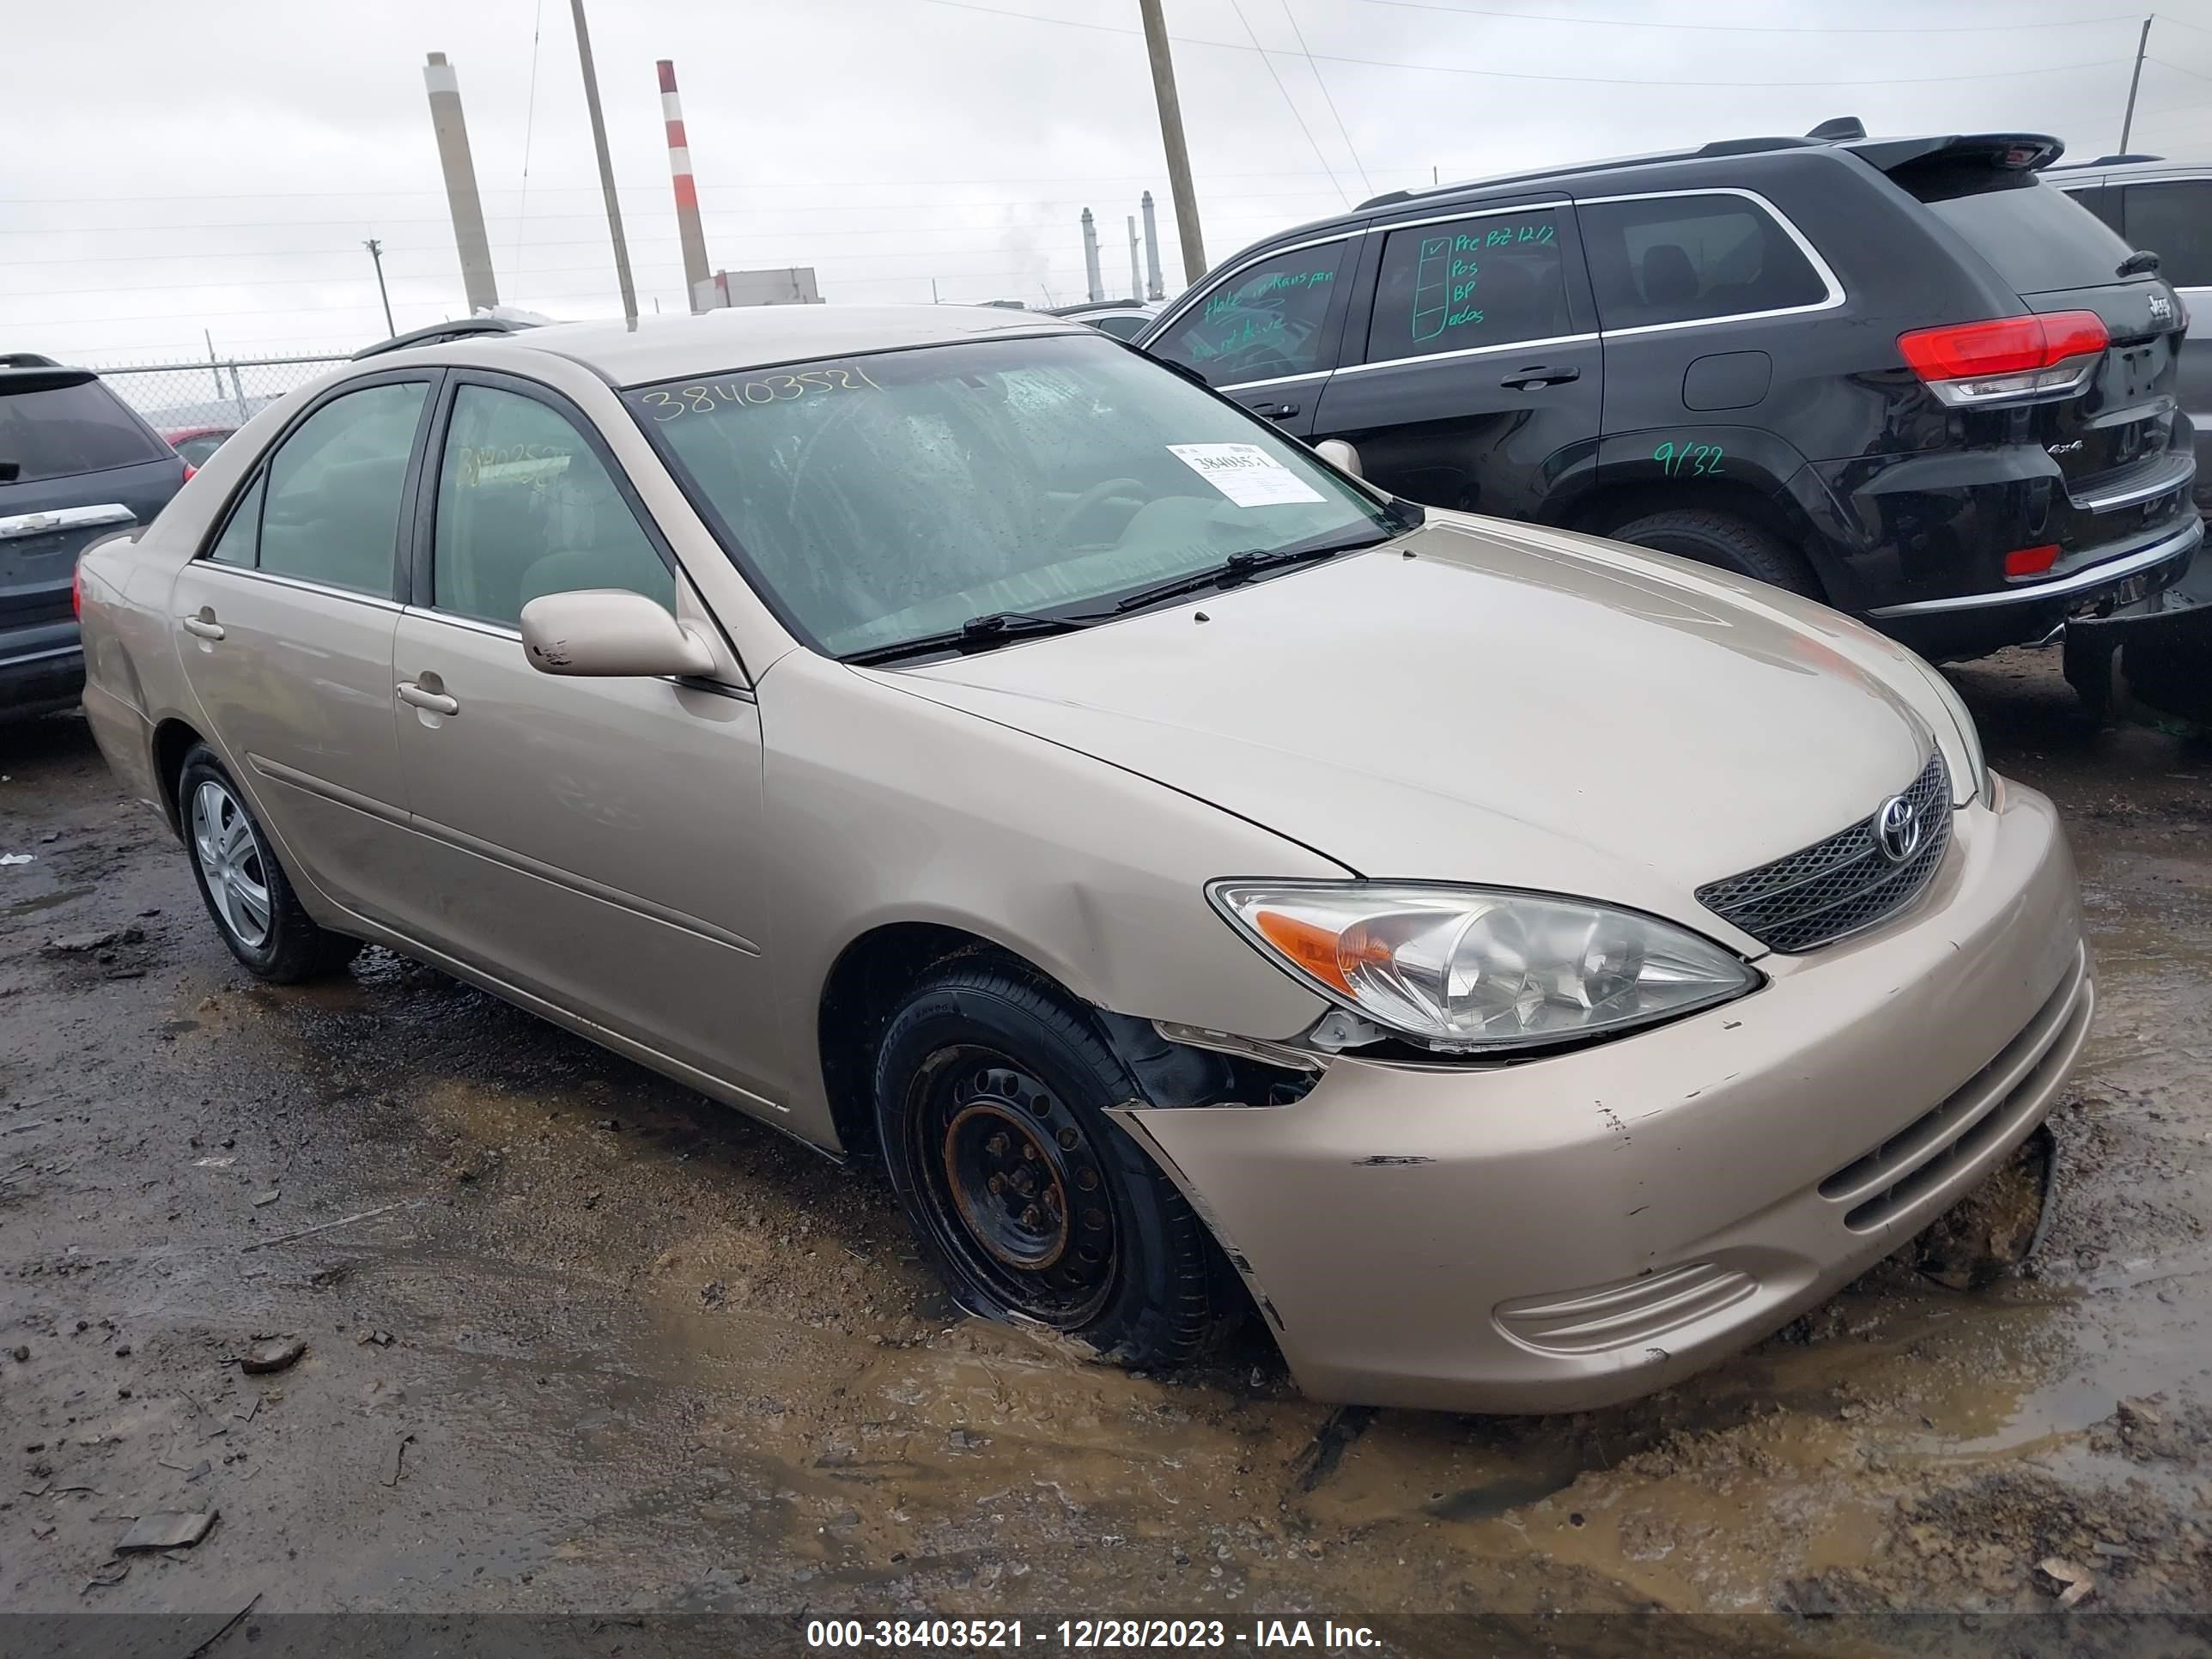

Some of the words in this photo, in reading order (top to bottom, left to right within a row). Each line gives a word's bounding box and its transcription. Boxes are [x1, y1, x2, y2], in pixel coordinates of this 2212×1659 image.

[1453, 281, 1476, 302] BP
[2148, 295, 2172, 319] Jeep
[642, 366, 883, 422] 38403521
[1653, 441, 1726, 477] 9/32
[2047, 440, 2083, 454] 4x4
